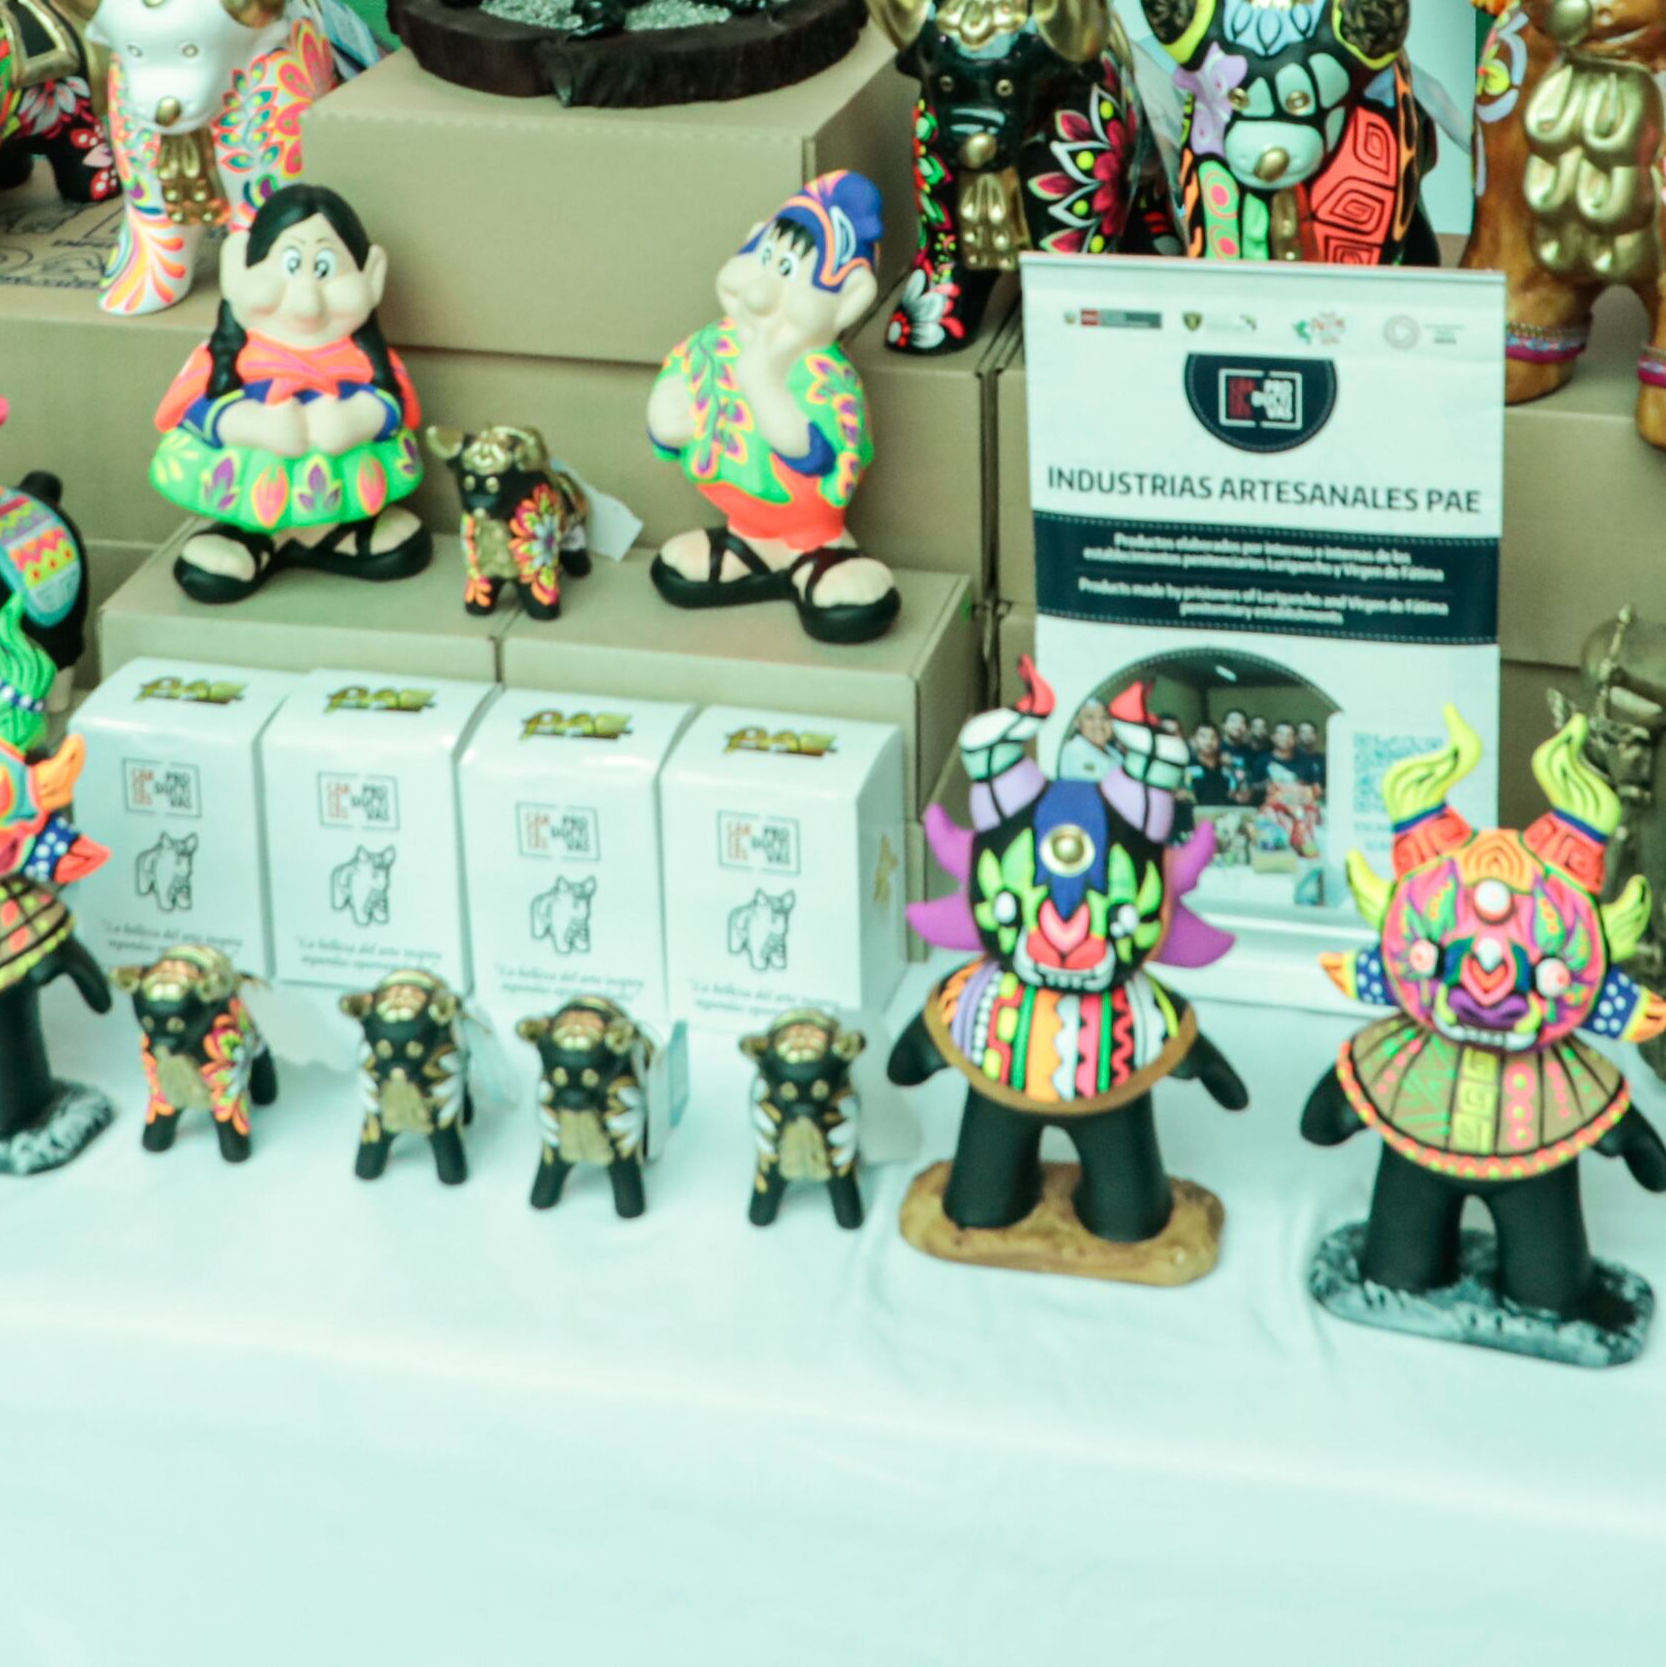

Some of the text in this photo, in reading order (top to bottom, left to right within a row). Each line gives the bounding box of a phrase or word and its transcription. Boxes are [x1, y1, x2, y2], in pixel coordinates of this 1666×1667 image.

[1047, 465, 1481, 514] INDUSTRIAS ARTESANALES PAE
